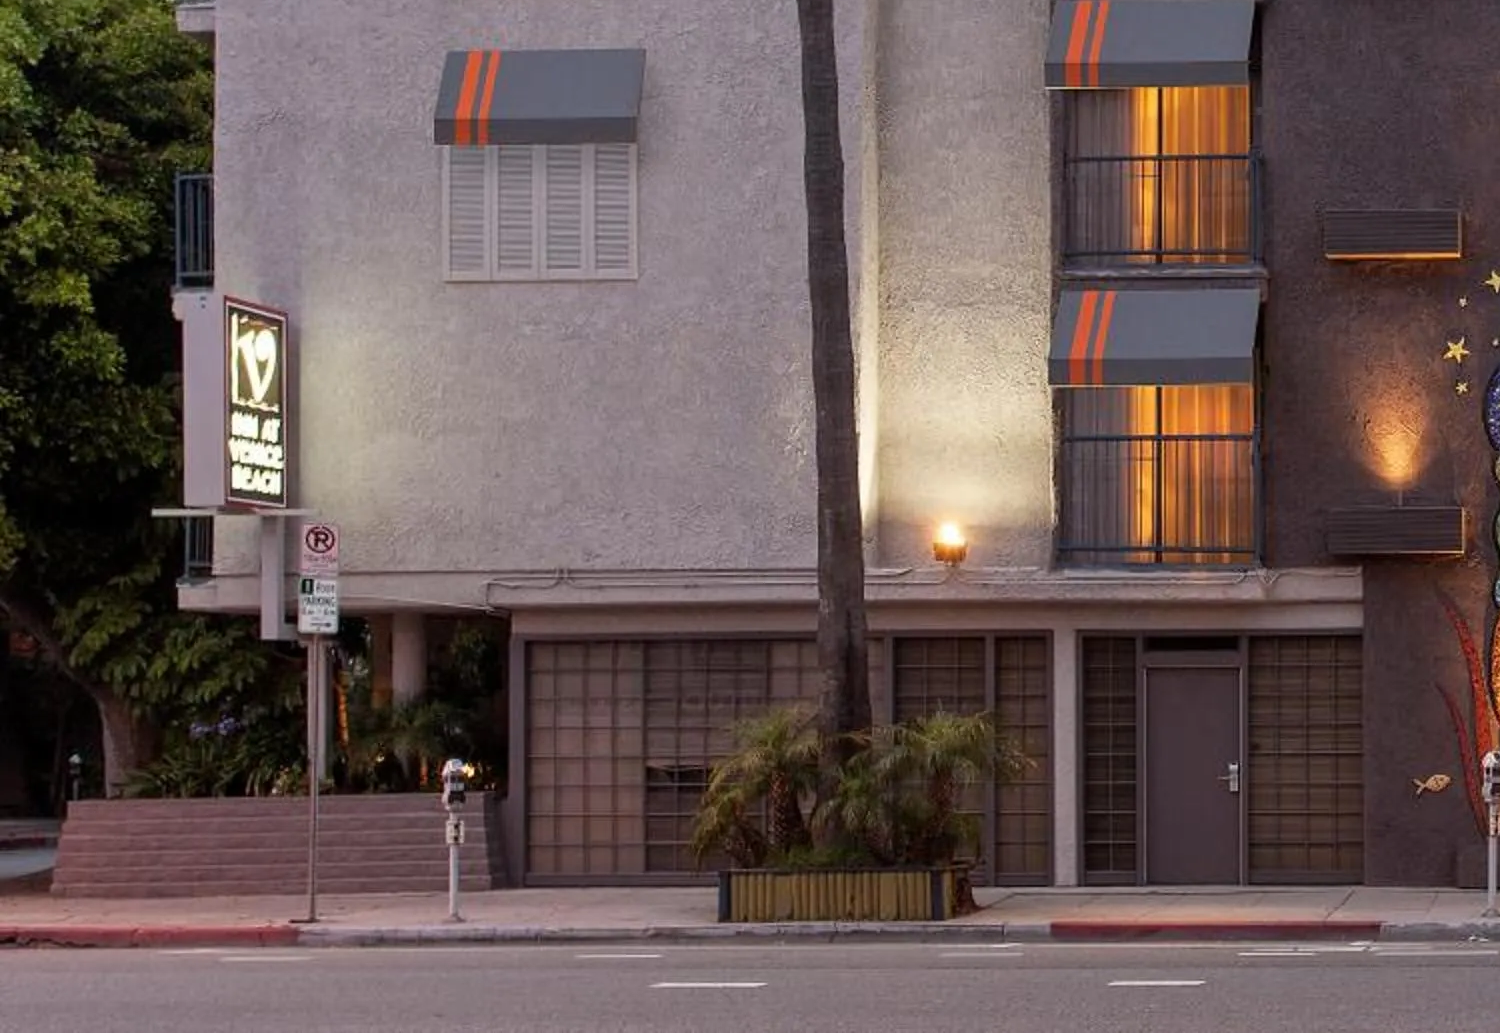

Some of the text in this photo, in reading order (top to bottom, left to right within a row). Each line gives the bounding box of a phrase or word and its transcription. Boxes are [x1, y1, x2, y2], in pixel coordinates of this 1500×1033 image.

[261, 418, 281, 444] AT
[228, 437, 285, 469] VENICE
[231, 464, 281, 496] BEACH
